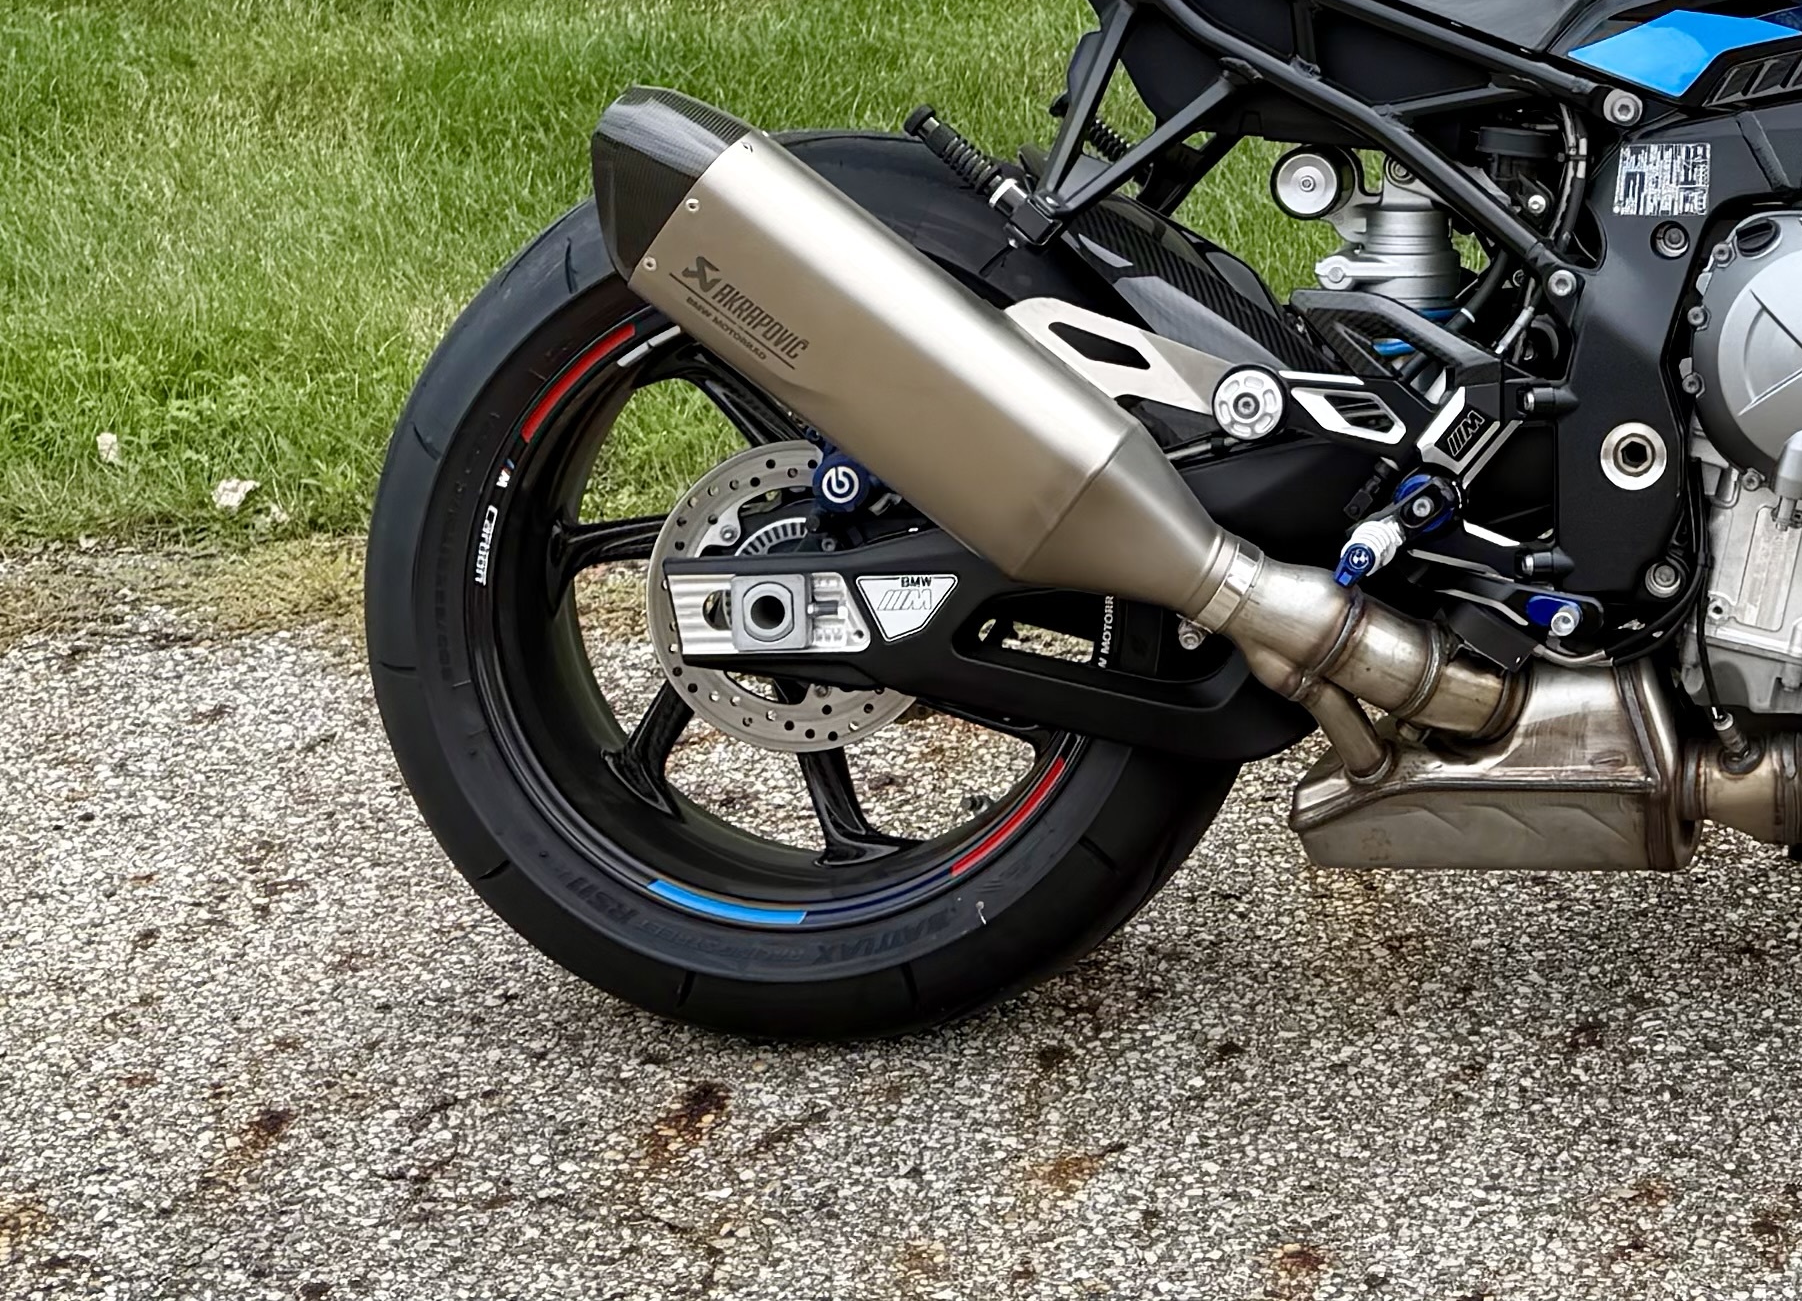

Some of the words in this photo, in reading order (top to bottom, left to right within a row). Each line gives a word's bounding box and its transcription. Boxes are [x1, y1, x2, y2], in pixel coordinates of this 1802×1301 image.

[686, 296, 712, 318] BMW
[712, 316, 767, 360] MOTORRAD
[901, 576, 932, 588] BMW
